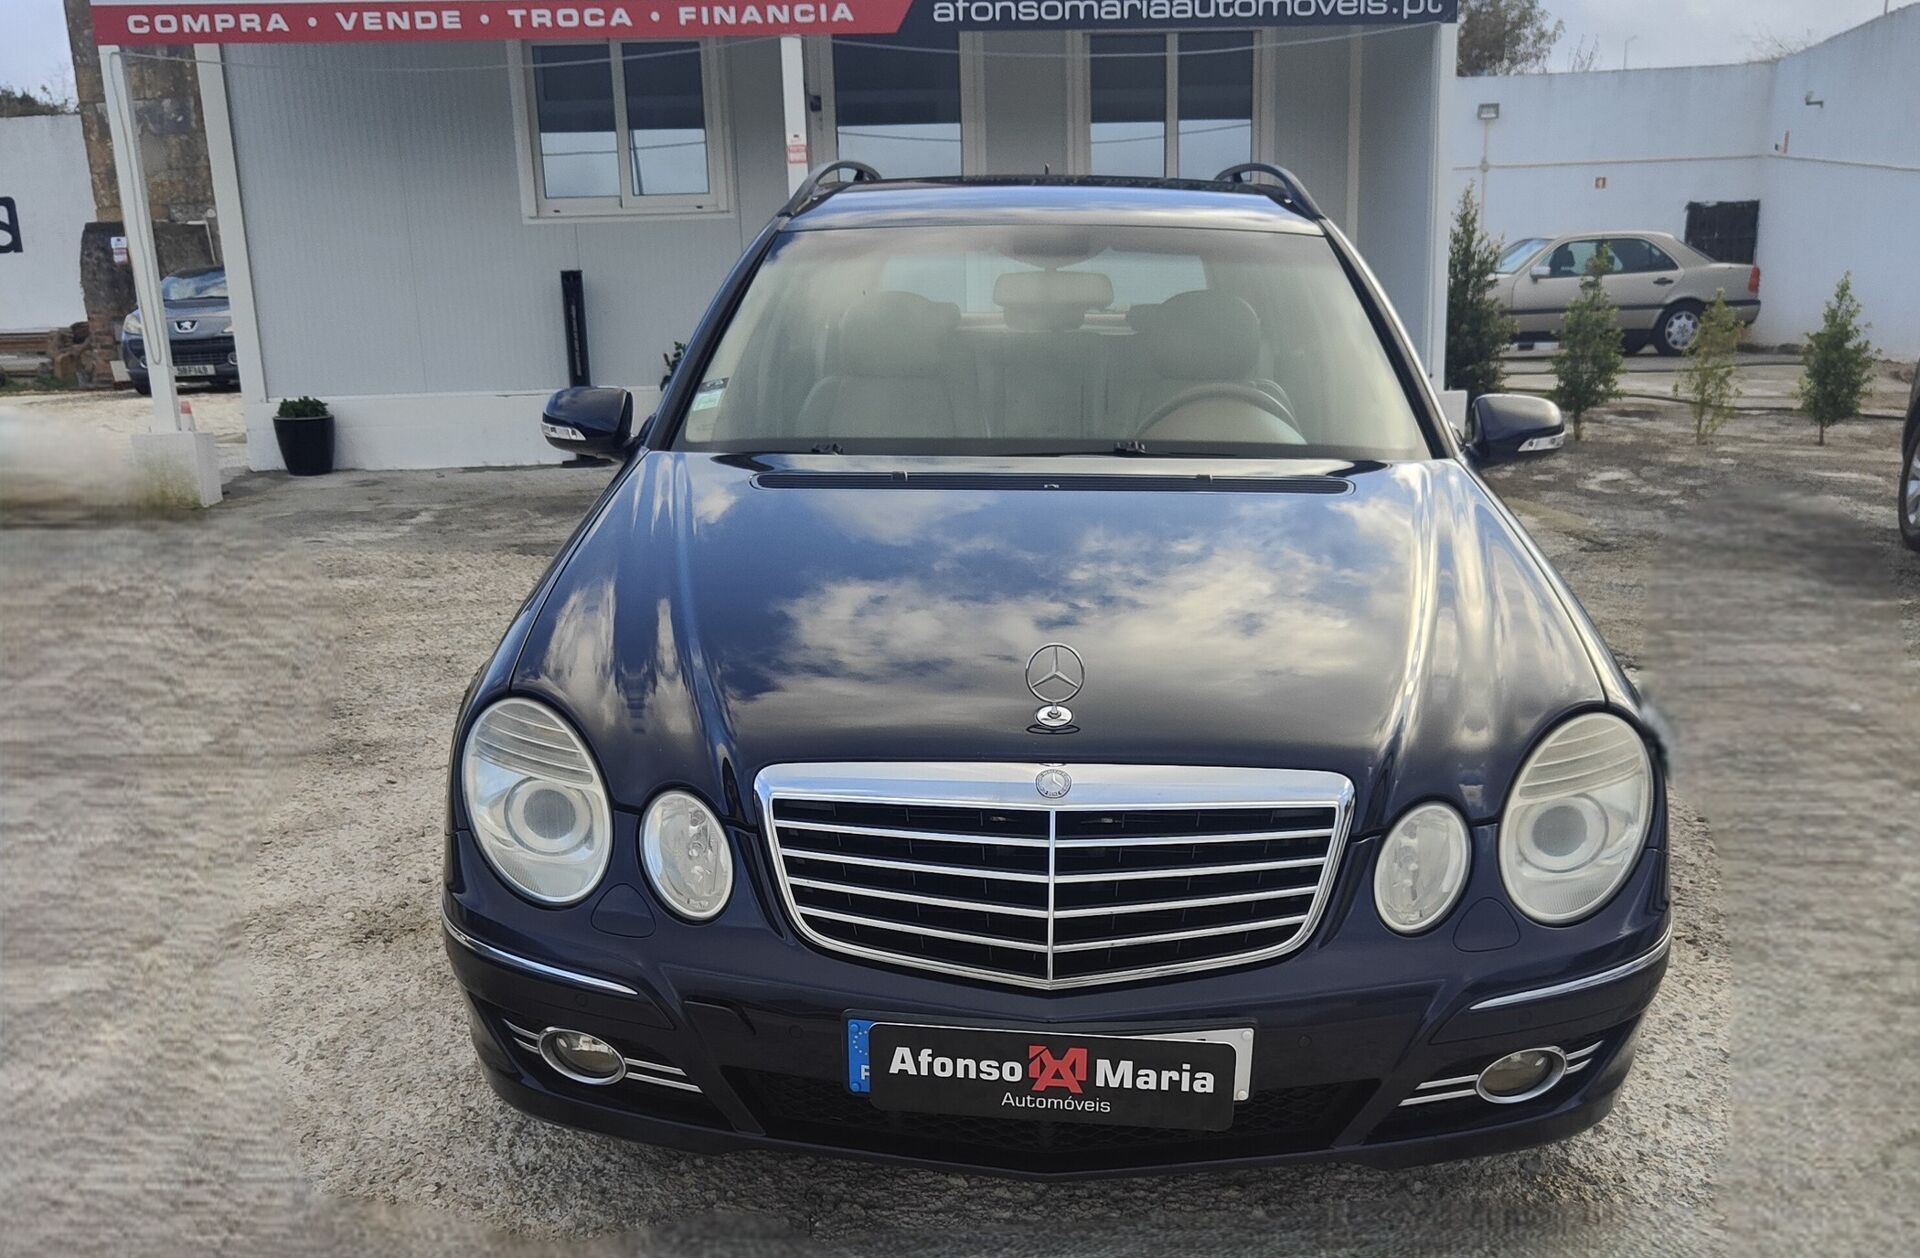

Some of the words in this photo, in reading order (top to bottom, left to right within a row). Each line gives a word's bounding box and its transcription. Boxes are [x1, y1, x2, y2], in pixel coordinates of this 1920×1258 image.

[127, 13, 290, 34] COMPRA
[335, 10, 463, 31] VENDE
[508, 6, 633, 28] TROCA
[679, 2, 855, 26] FINANCIA
[889, 1046, 1023, 1082] Afonso
[1095, 1058, 1215, 1093] Maria
[1001, 1092, 1111, 1113] Automóveis
